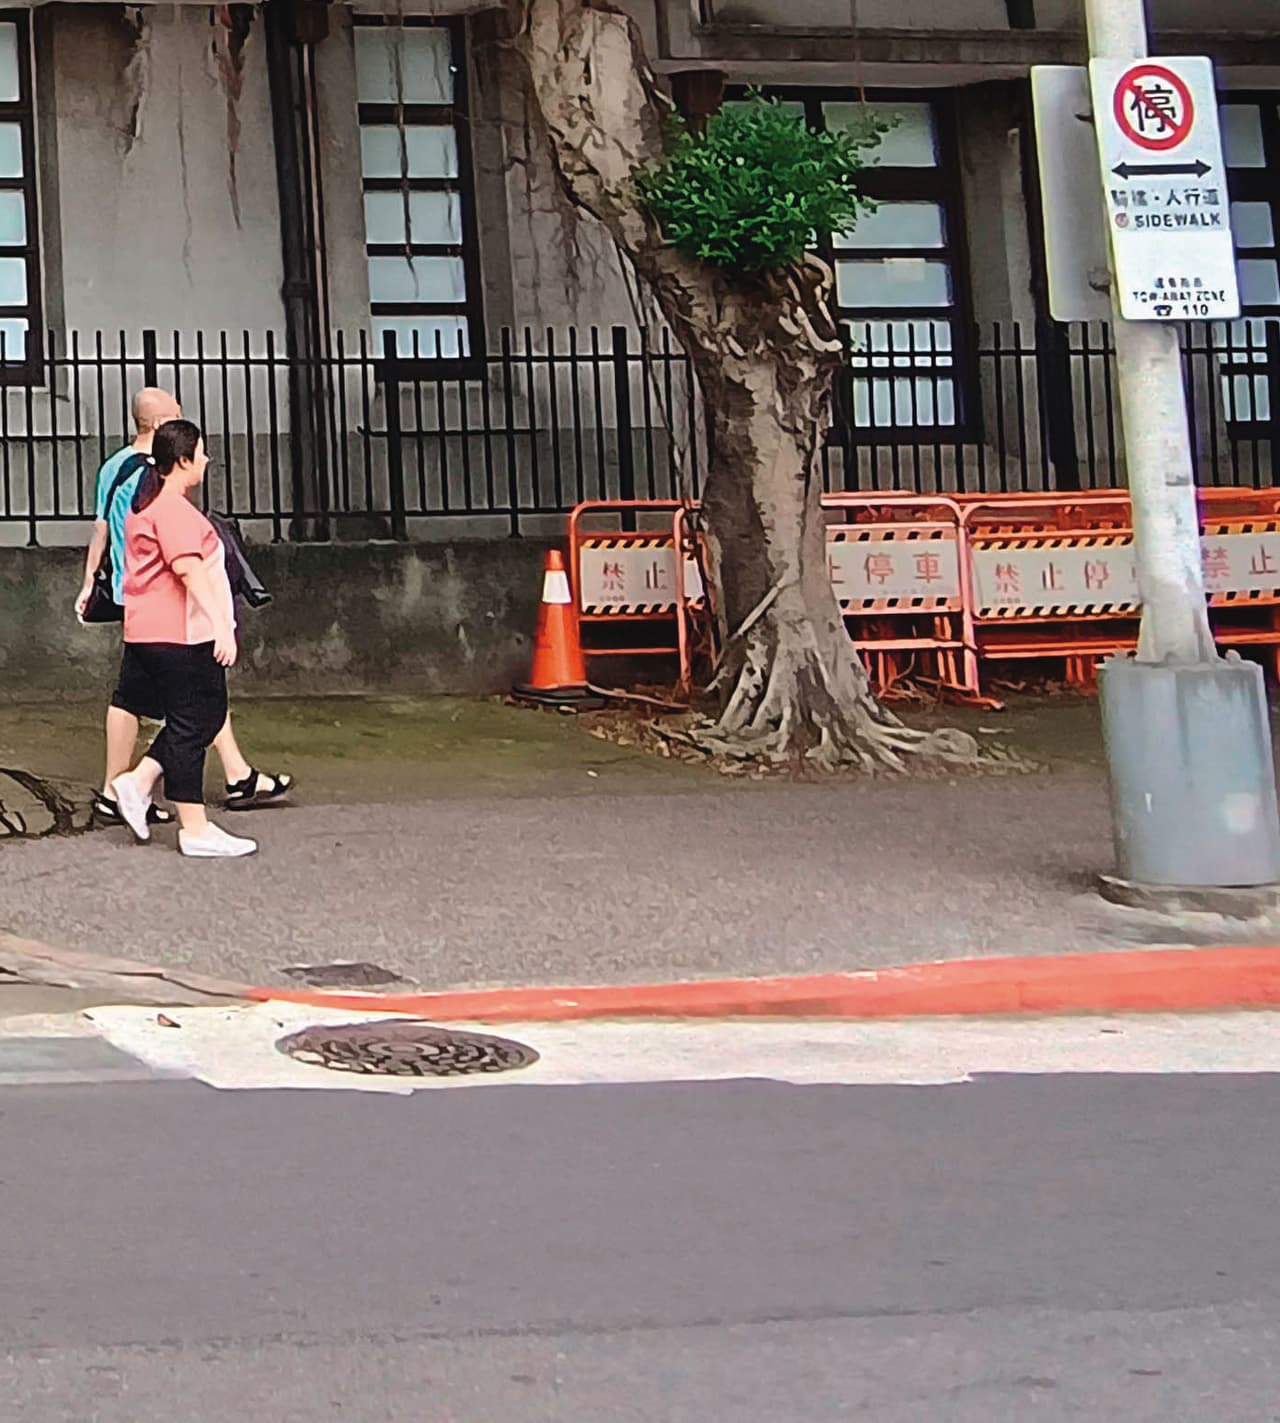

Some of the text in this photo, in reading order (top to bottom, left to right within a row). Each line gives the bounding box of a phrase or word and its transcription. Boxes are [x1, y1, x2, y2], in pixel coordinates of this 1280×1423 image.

[1130, 84, 1177, 132] 停
[1134, 212, 1221, 228] SIDEWALK
[1182, 304, 1209, 316] 110
[601, 561, 668, 591] 禁止
[994, 559, 1137, 593] 禁止停
